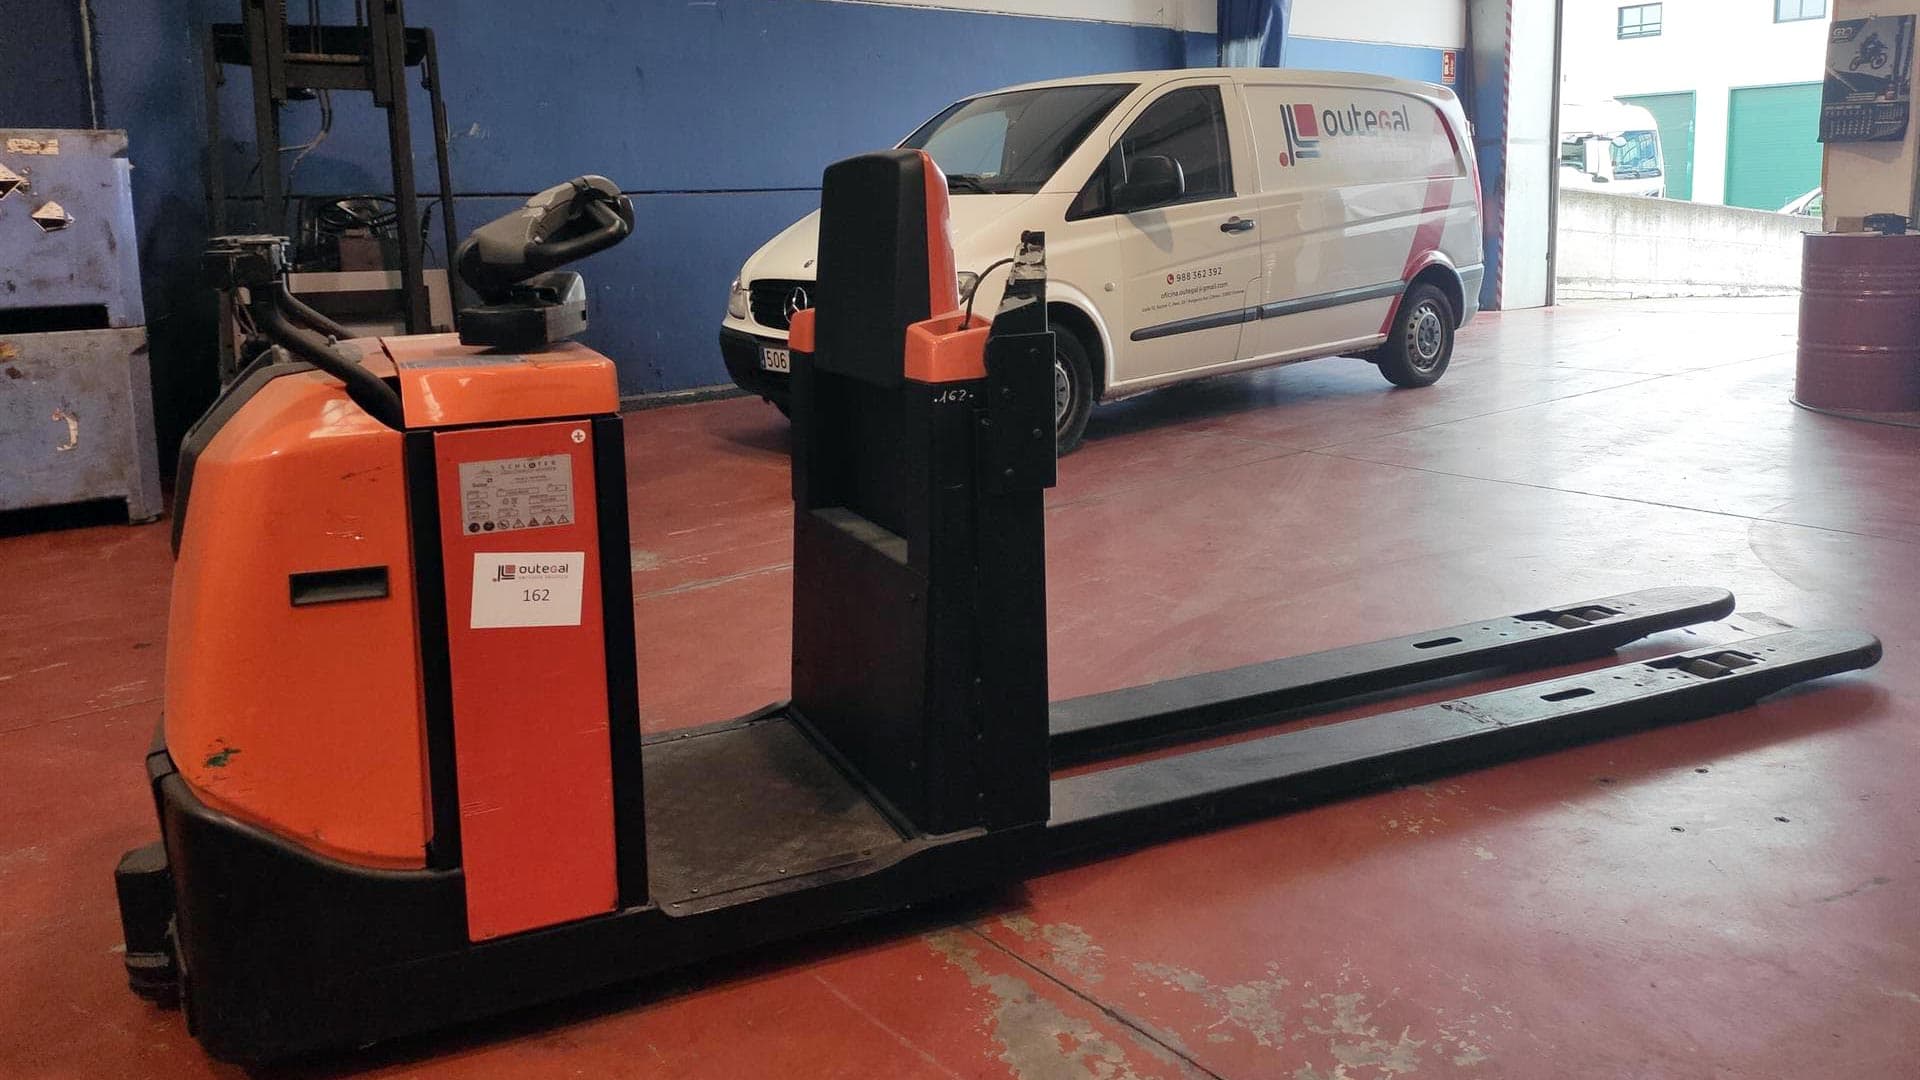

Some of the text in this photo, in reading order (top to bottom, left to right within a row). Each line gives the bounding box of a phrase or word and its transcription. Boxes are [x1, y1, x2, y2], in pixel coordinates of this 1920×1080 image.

[1176, 266, 1222, 282] 988 362 392
[523, 588, 550, 602] 162
